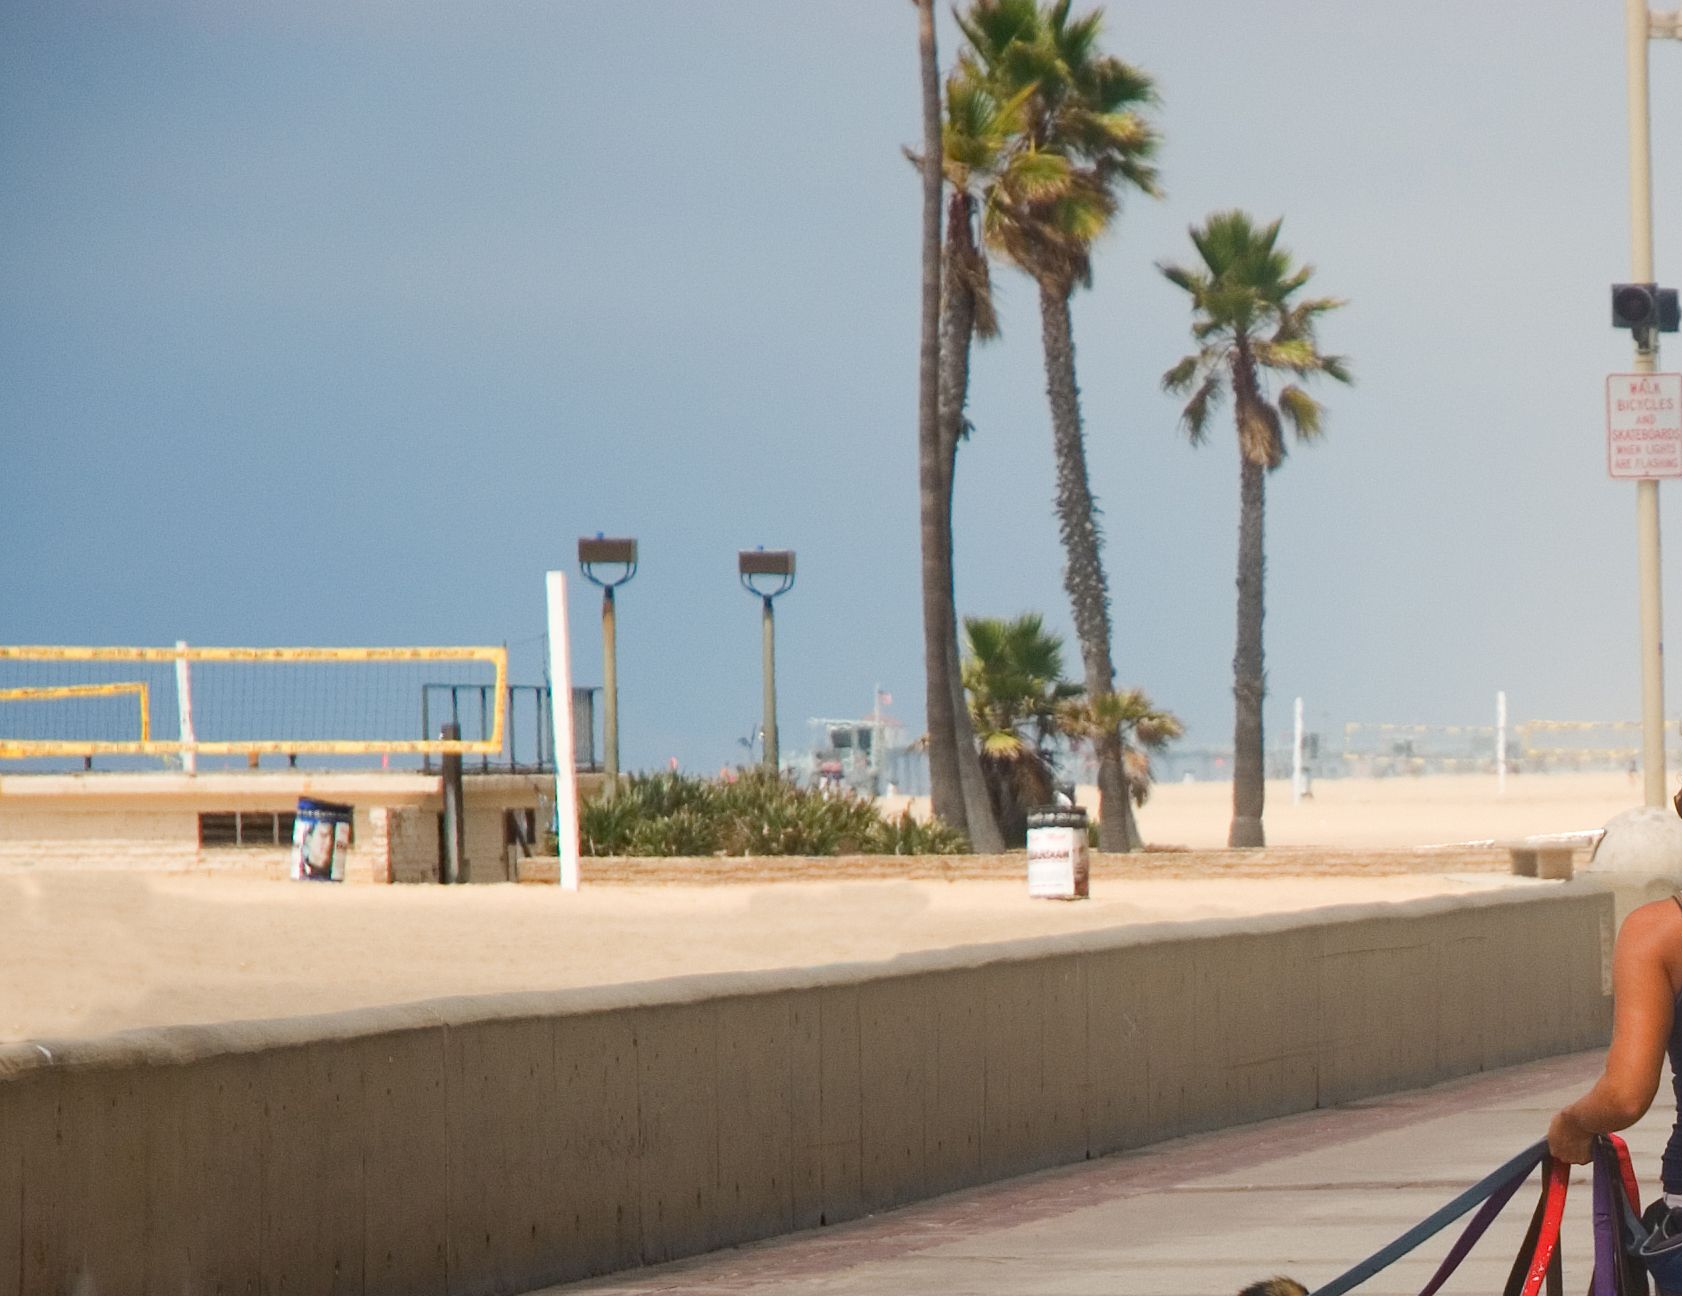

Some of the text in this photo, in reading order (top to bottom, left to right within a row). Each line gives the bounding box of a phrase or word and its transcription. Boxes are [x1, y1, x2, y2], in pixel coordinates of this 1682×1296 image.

[1629, 383, 1661, 394] WALK
[1617, 399, 1674, 411] BICYCLES
[1635, 414, 1656, 425] AND
[1612, 428, 1680, 440] SKATEBOARDS
